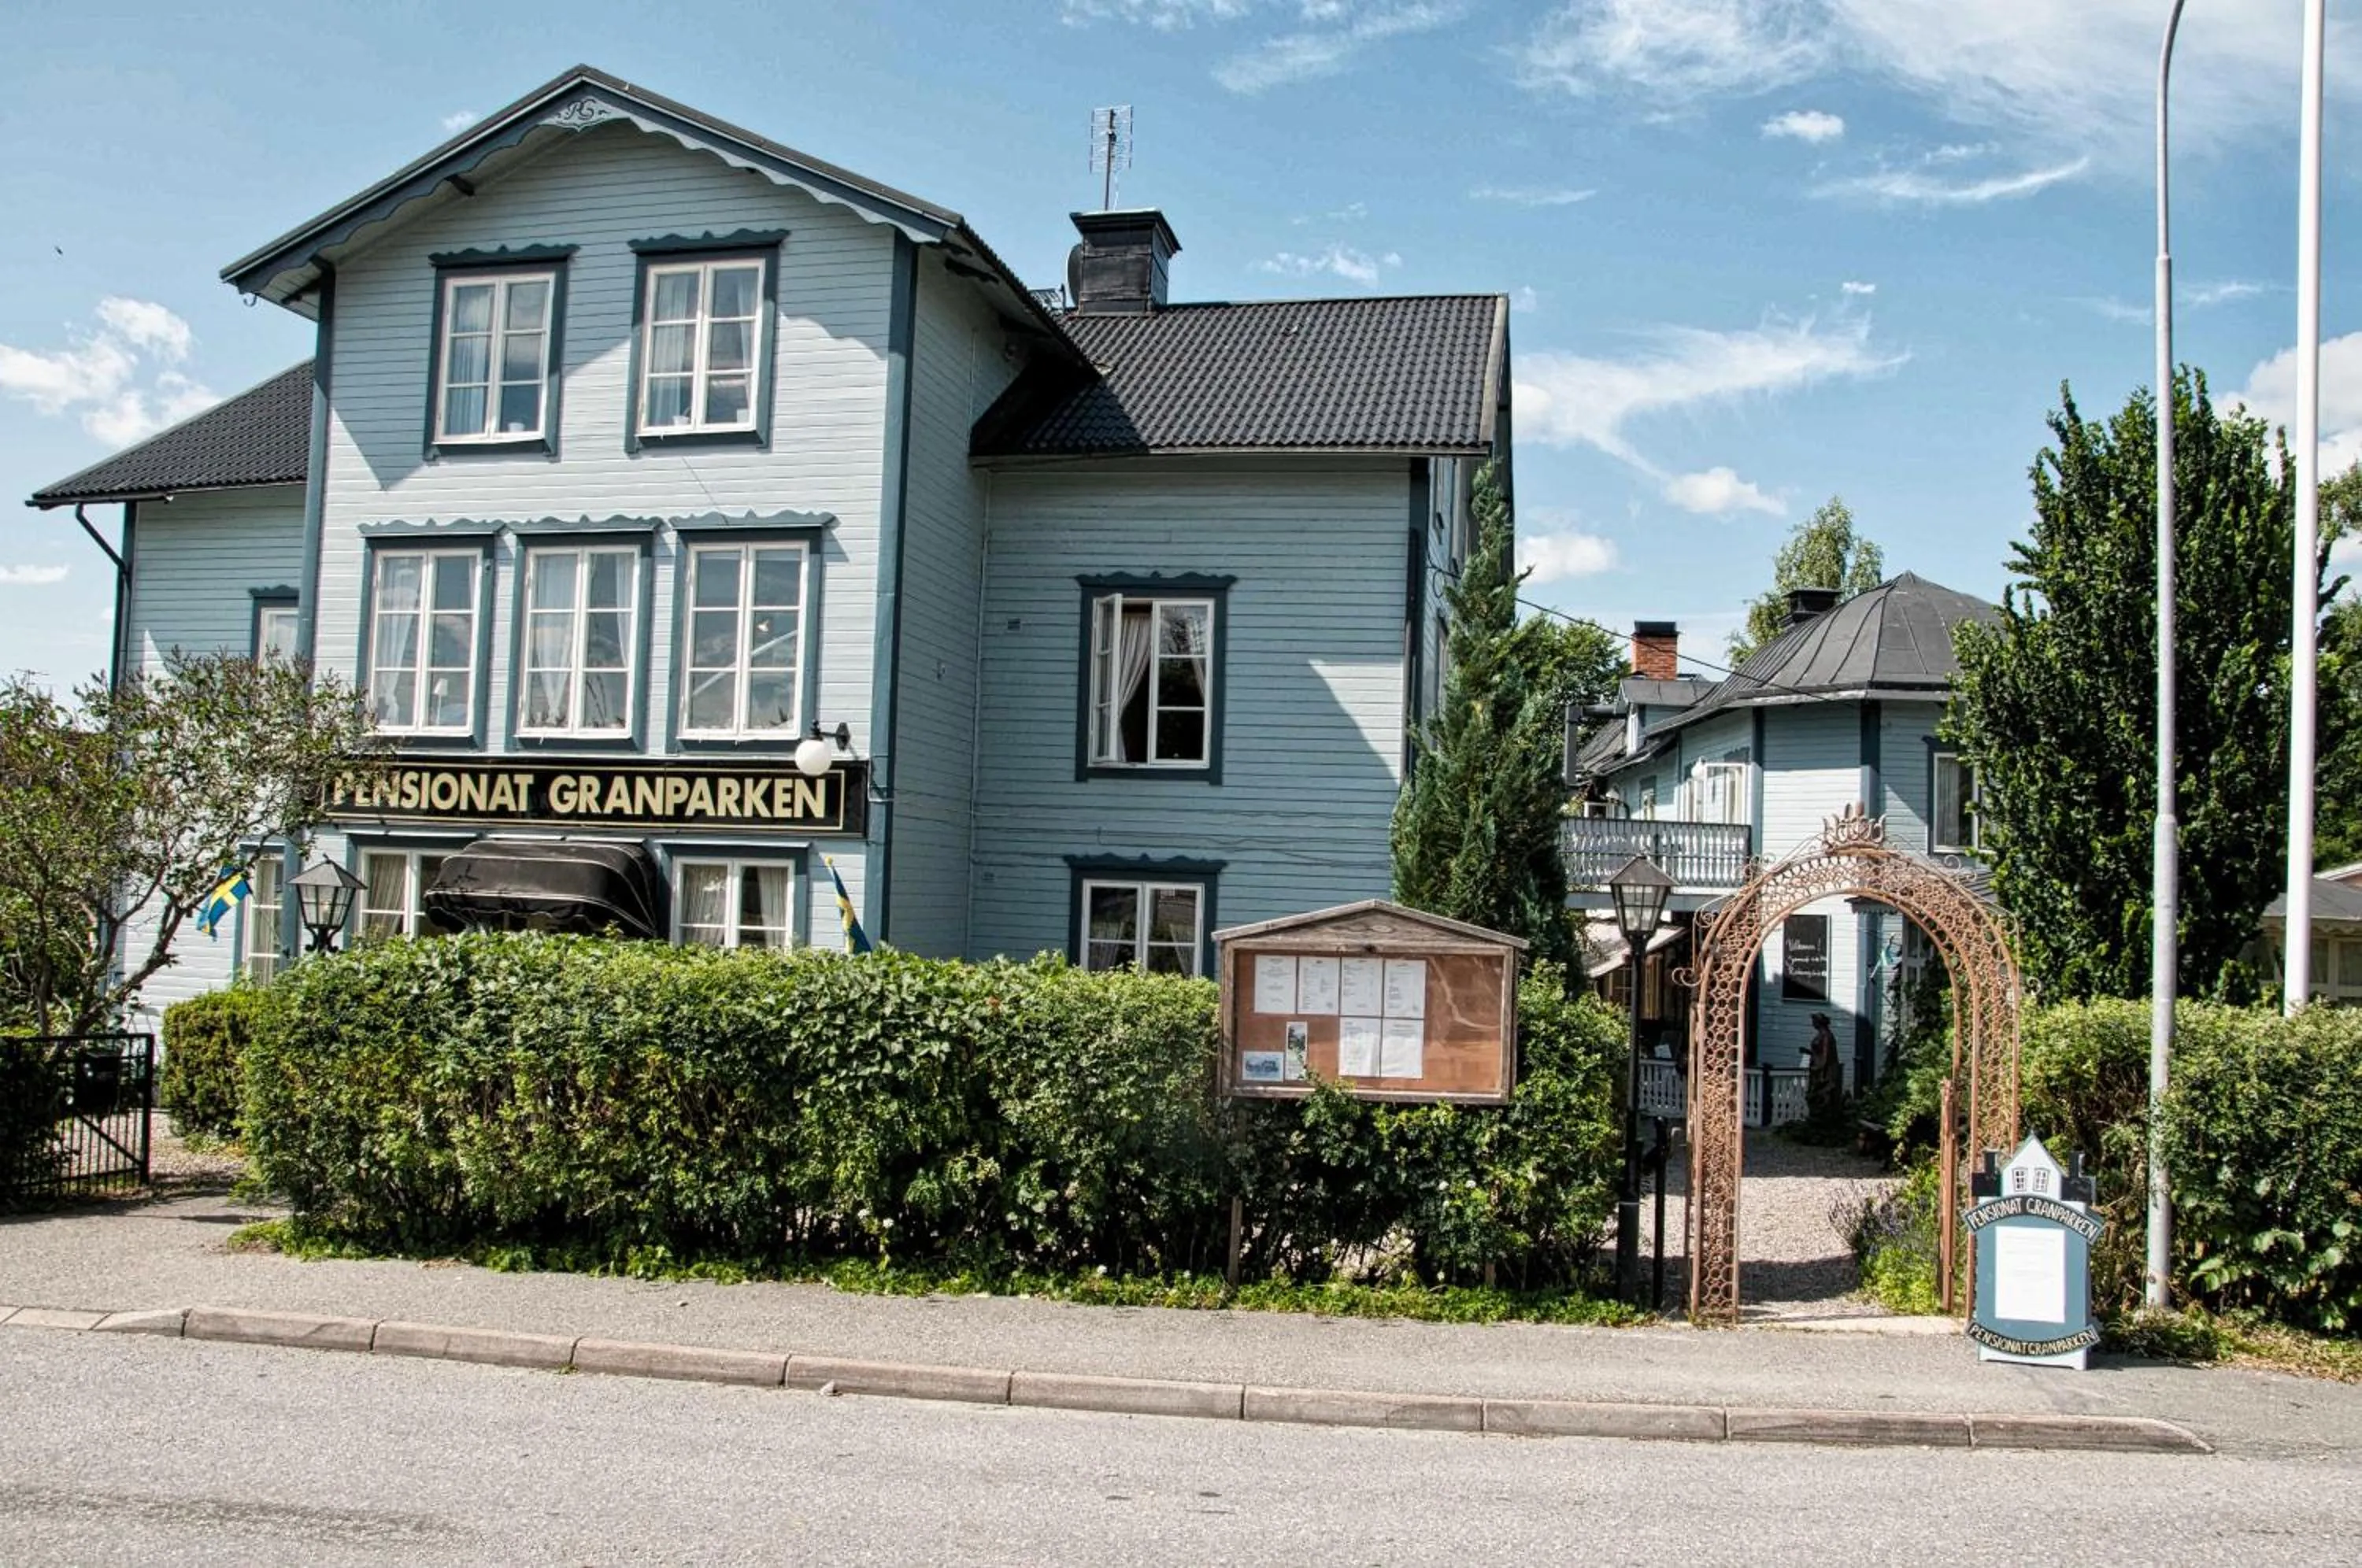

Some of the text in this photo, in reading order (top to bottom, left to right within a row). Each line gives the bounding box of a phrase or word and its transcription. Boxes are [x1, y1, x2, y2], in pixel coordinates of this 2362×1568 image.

[333, 770, 826, 819] PENSIONAT GRANPARKEN
[1968, 1197, 2023, 1230] PENSIONAT
[1969, 1325, 2027, 1355] PENSIONAT
